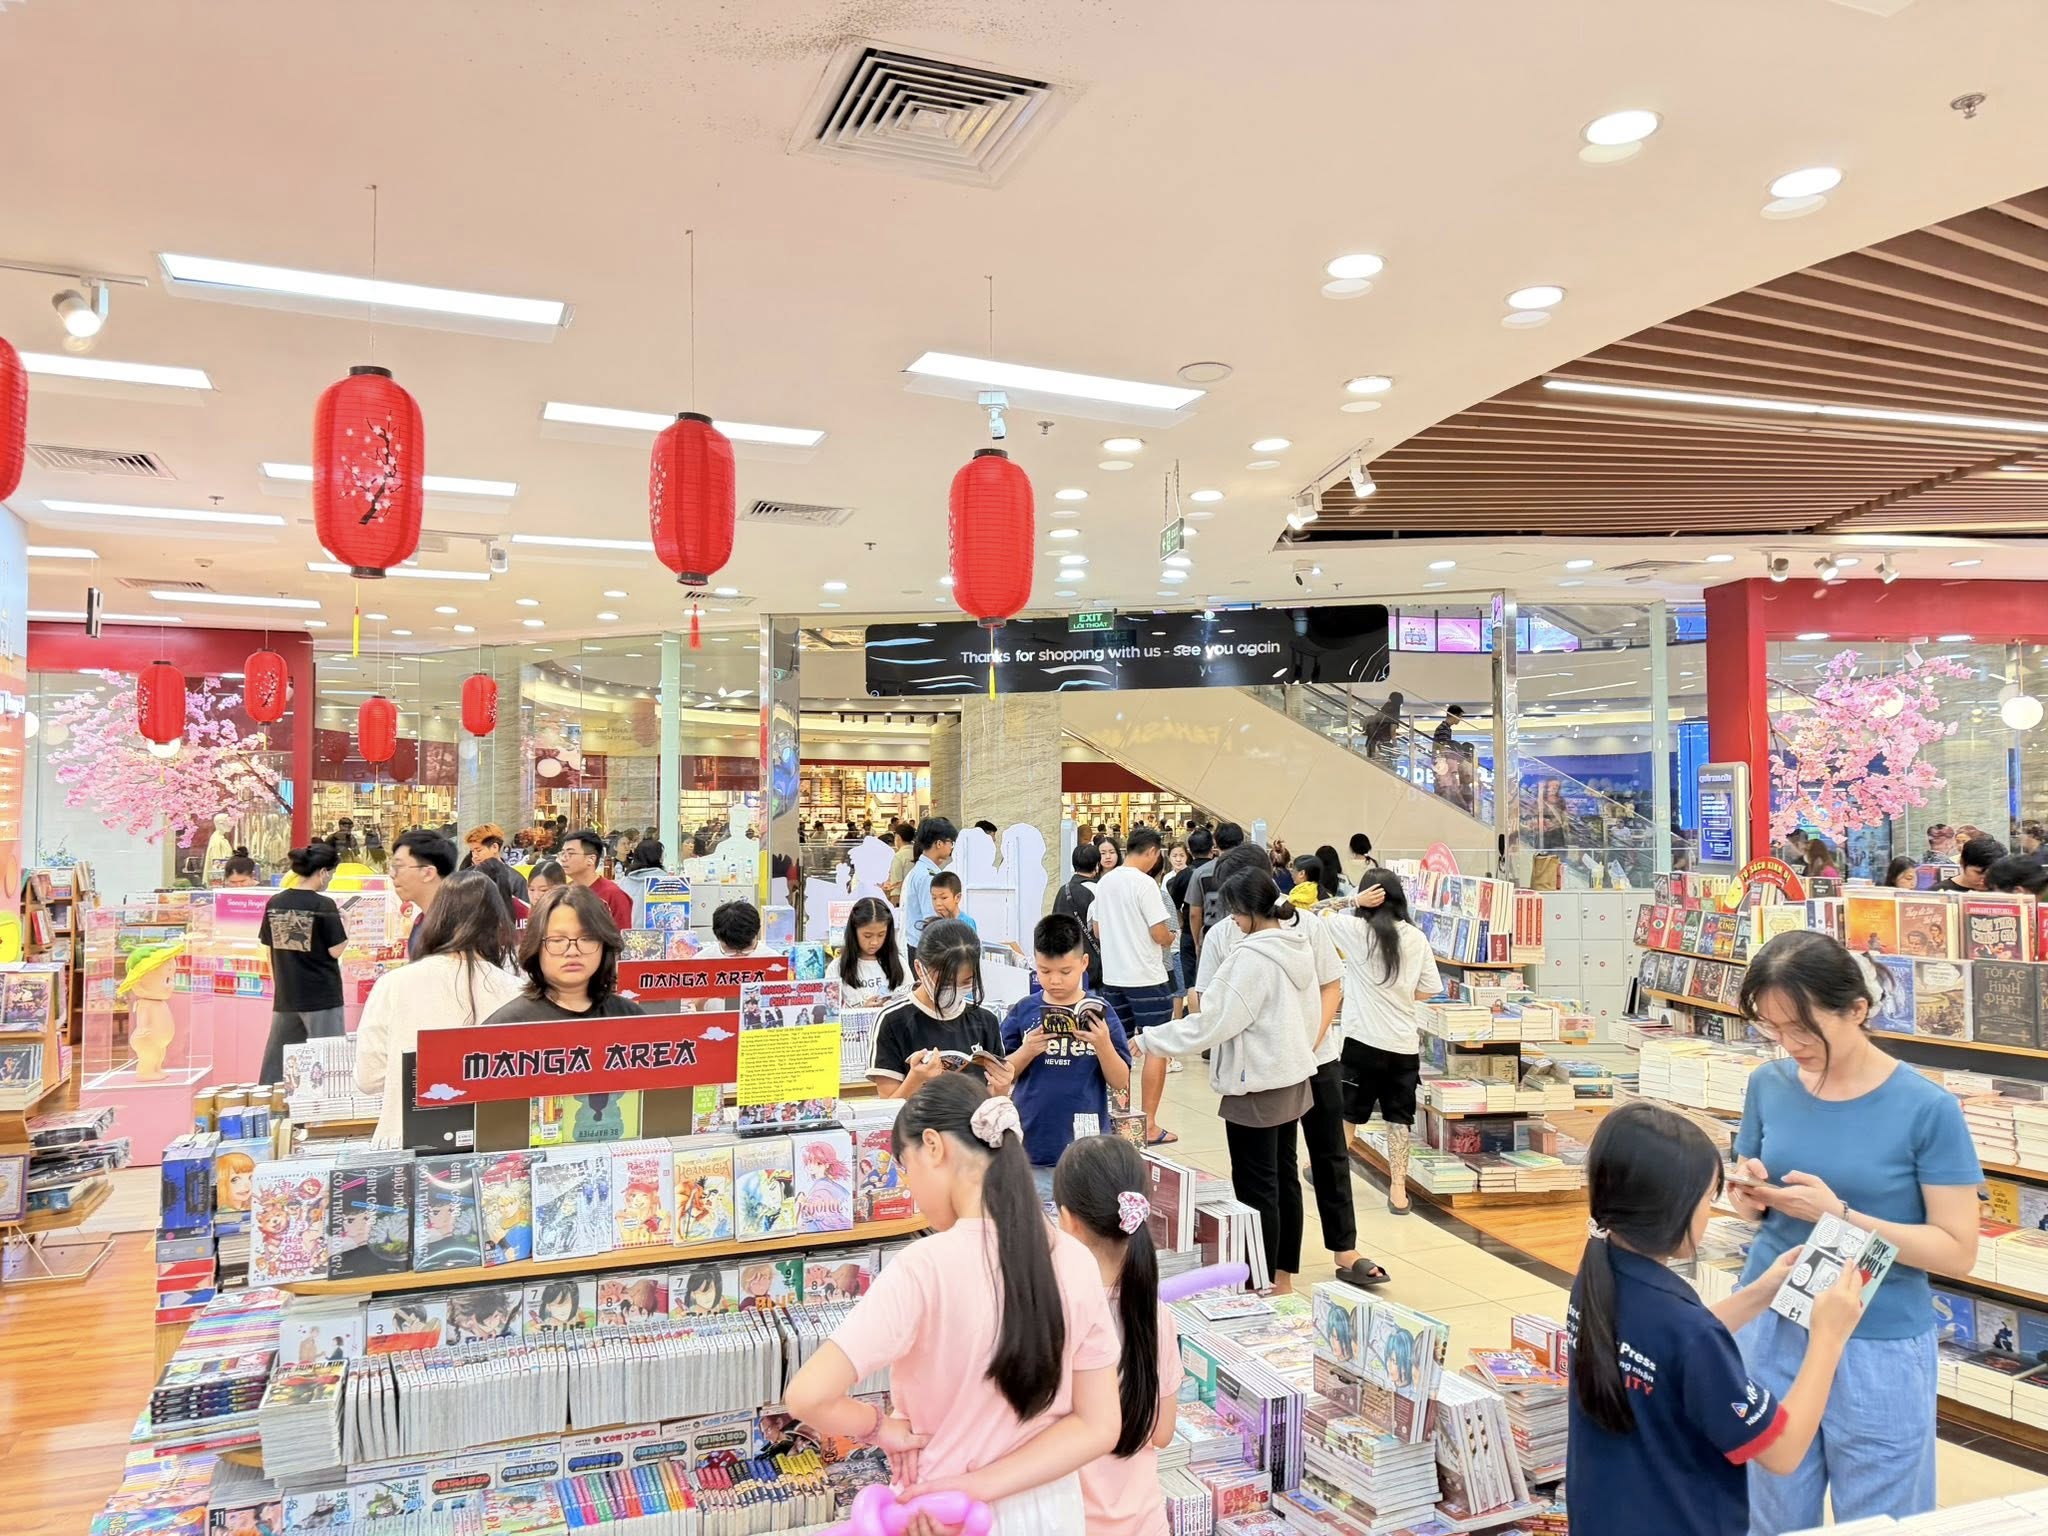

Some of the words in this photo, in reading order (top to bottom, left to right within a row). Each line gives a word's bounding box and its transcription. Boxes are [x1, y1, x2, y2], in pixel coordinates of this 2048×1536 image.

[1079, 613, 1103, 622] EXIT
[960, 651, 1010, 664] Thanks
[1015, 648, 1035, 662] for
[1038, 648, 1103, 666] shopping
[1108, 646, 1140, 660] with
[1143, 648, 1160, 659] us
[1173, 645, 1201, 657] see
[1205, 644, 1234, 659] you
[1237, 642, 1281, 658] again
[866, 772, 913, 793] MUJI
[640, 973, 708, 988] MANGA
[716, 970, 766, 985] AREA
[760, 984, 792, 995] MANGA
[797, 983, 823, 993] COMIC
[463, 1046, 592, 1080] MANGA
[605, 1040, 696, 1072] AREA
[677, 1278, 684, 1288] 7
[810, 1280, 818, 1290] 8
[531, 1290, 538, 1300] 7
[606, 1297, 613, 1307] 8
[376, 1324, 384, 1334] 3
[1619, 1341, 1656, 1372] Press
[1624, 1374, 1653, 1396] ITY
